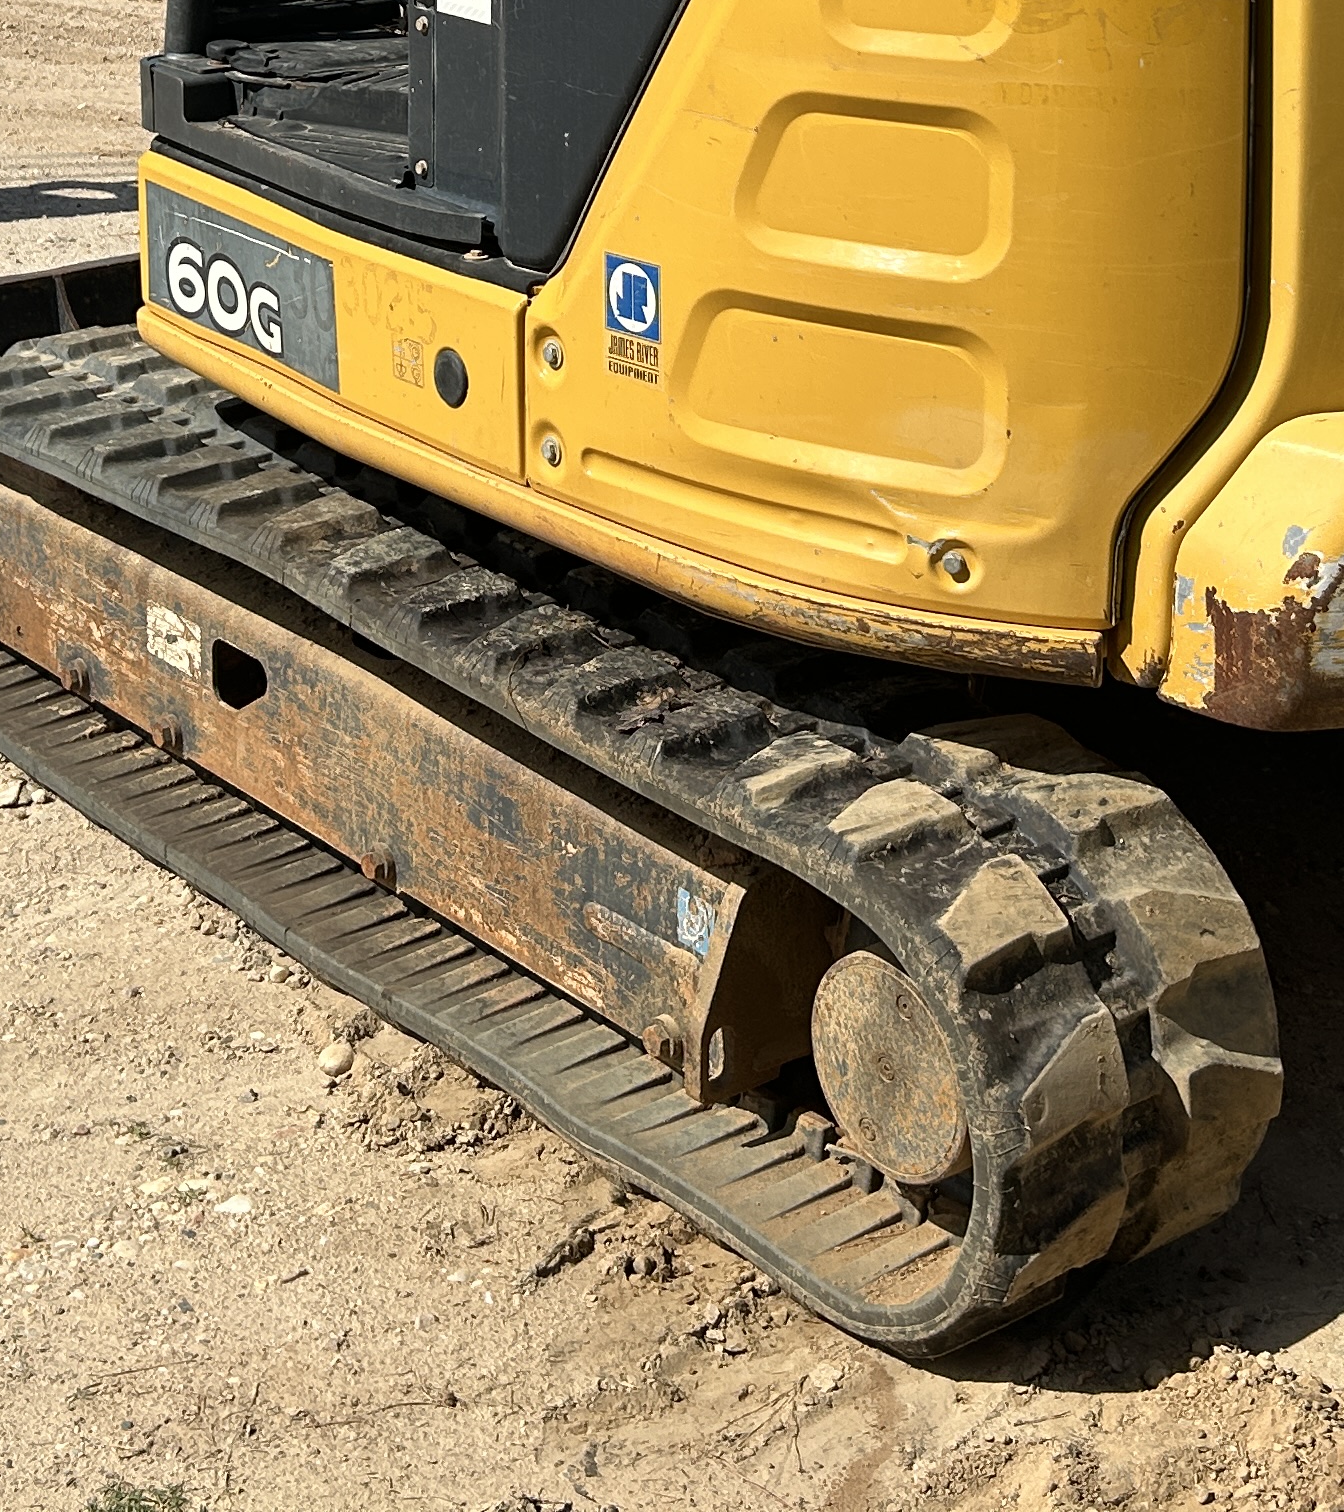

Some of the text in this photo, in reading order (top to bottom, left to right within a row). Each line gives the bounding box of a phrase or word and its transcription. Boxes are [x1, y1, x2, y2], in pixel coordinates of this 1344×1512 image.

[166, 238, 284, 356] 60G
[608, 334, 635, 361] JAMES
[608, 360, 660, 385] EQUIPMENT
